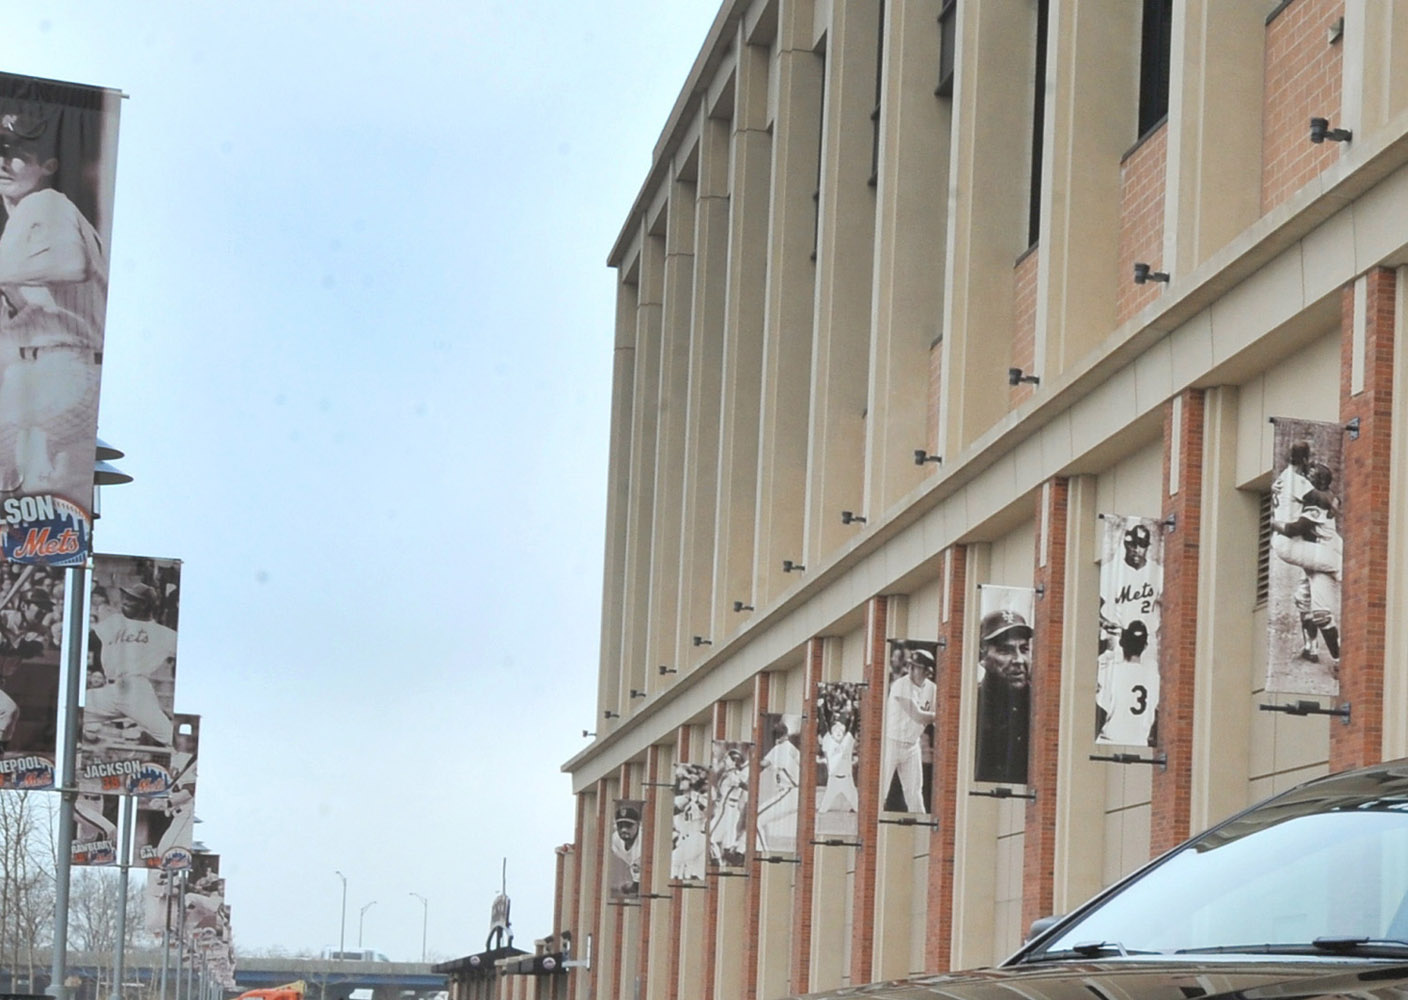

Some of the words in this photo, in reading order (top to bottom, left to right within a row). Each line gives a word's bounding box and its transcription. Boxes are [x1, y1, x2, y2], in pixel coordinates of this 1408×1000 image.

[13, 527, 79, 558] Mets
[1114, 582, 1154, 604] Mets
[108, 627, 149, 646] Mets
[1129, 684, 1148, 715] 3
[84, 760, 140, 779] JACKSON
